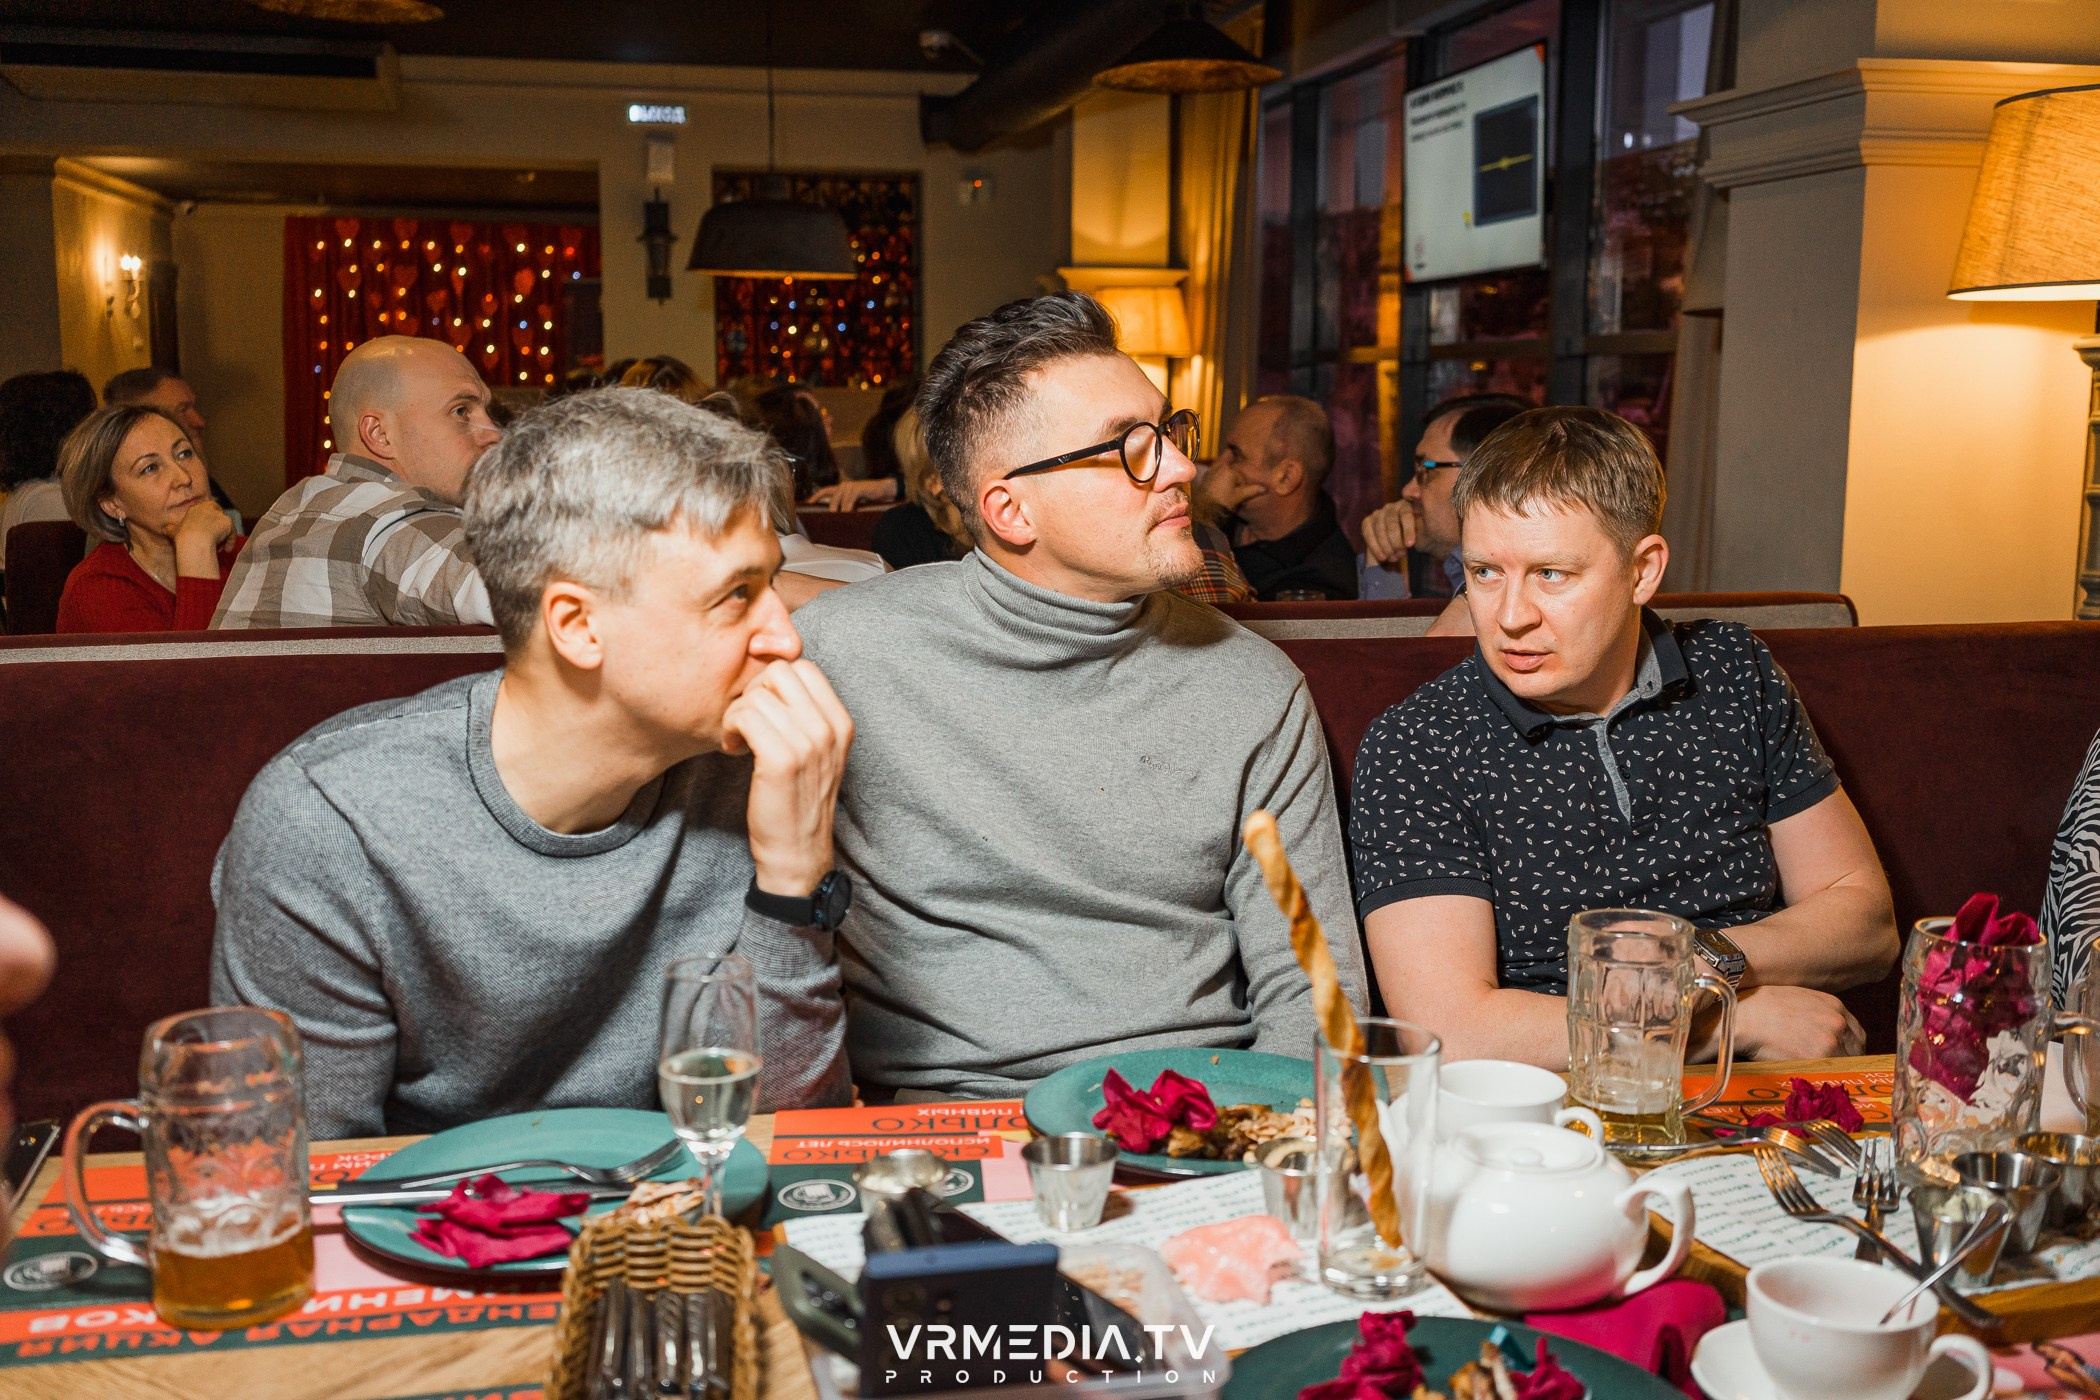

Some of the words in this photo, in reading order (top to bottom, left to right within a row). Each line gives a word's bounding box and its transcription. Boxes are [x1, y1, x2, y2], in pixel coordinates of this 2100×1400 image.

[917, 1107, 1012, 1116] ПИВНЫХ
[870, 1116, 1028, 1132] ОЛЬКО
[796, 1140, 834, 1149] ЛЕТ
[837, 1137, 990, 1148] ИСПОЛНИЛОСЬ
[782, 1145, 990, 1161] СКЬКО
[245, 1304, 557, 1342] ЕНДАРНАЯ
